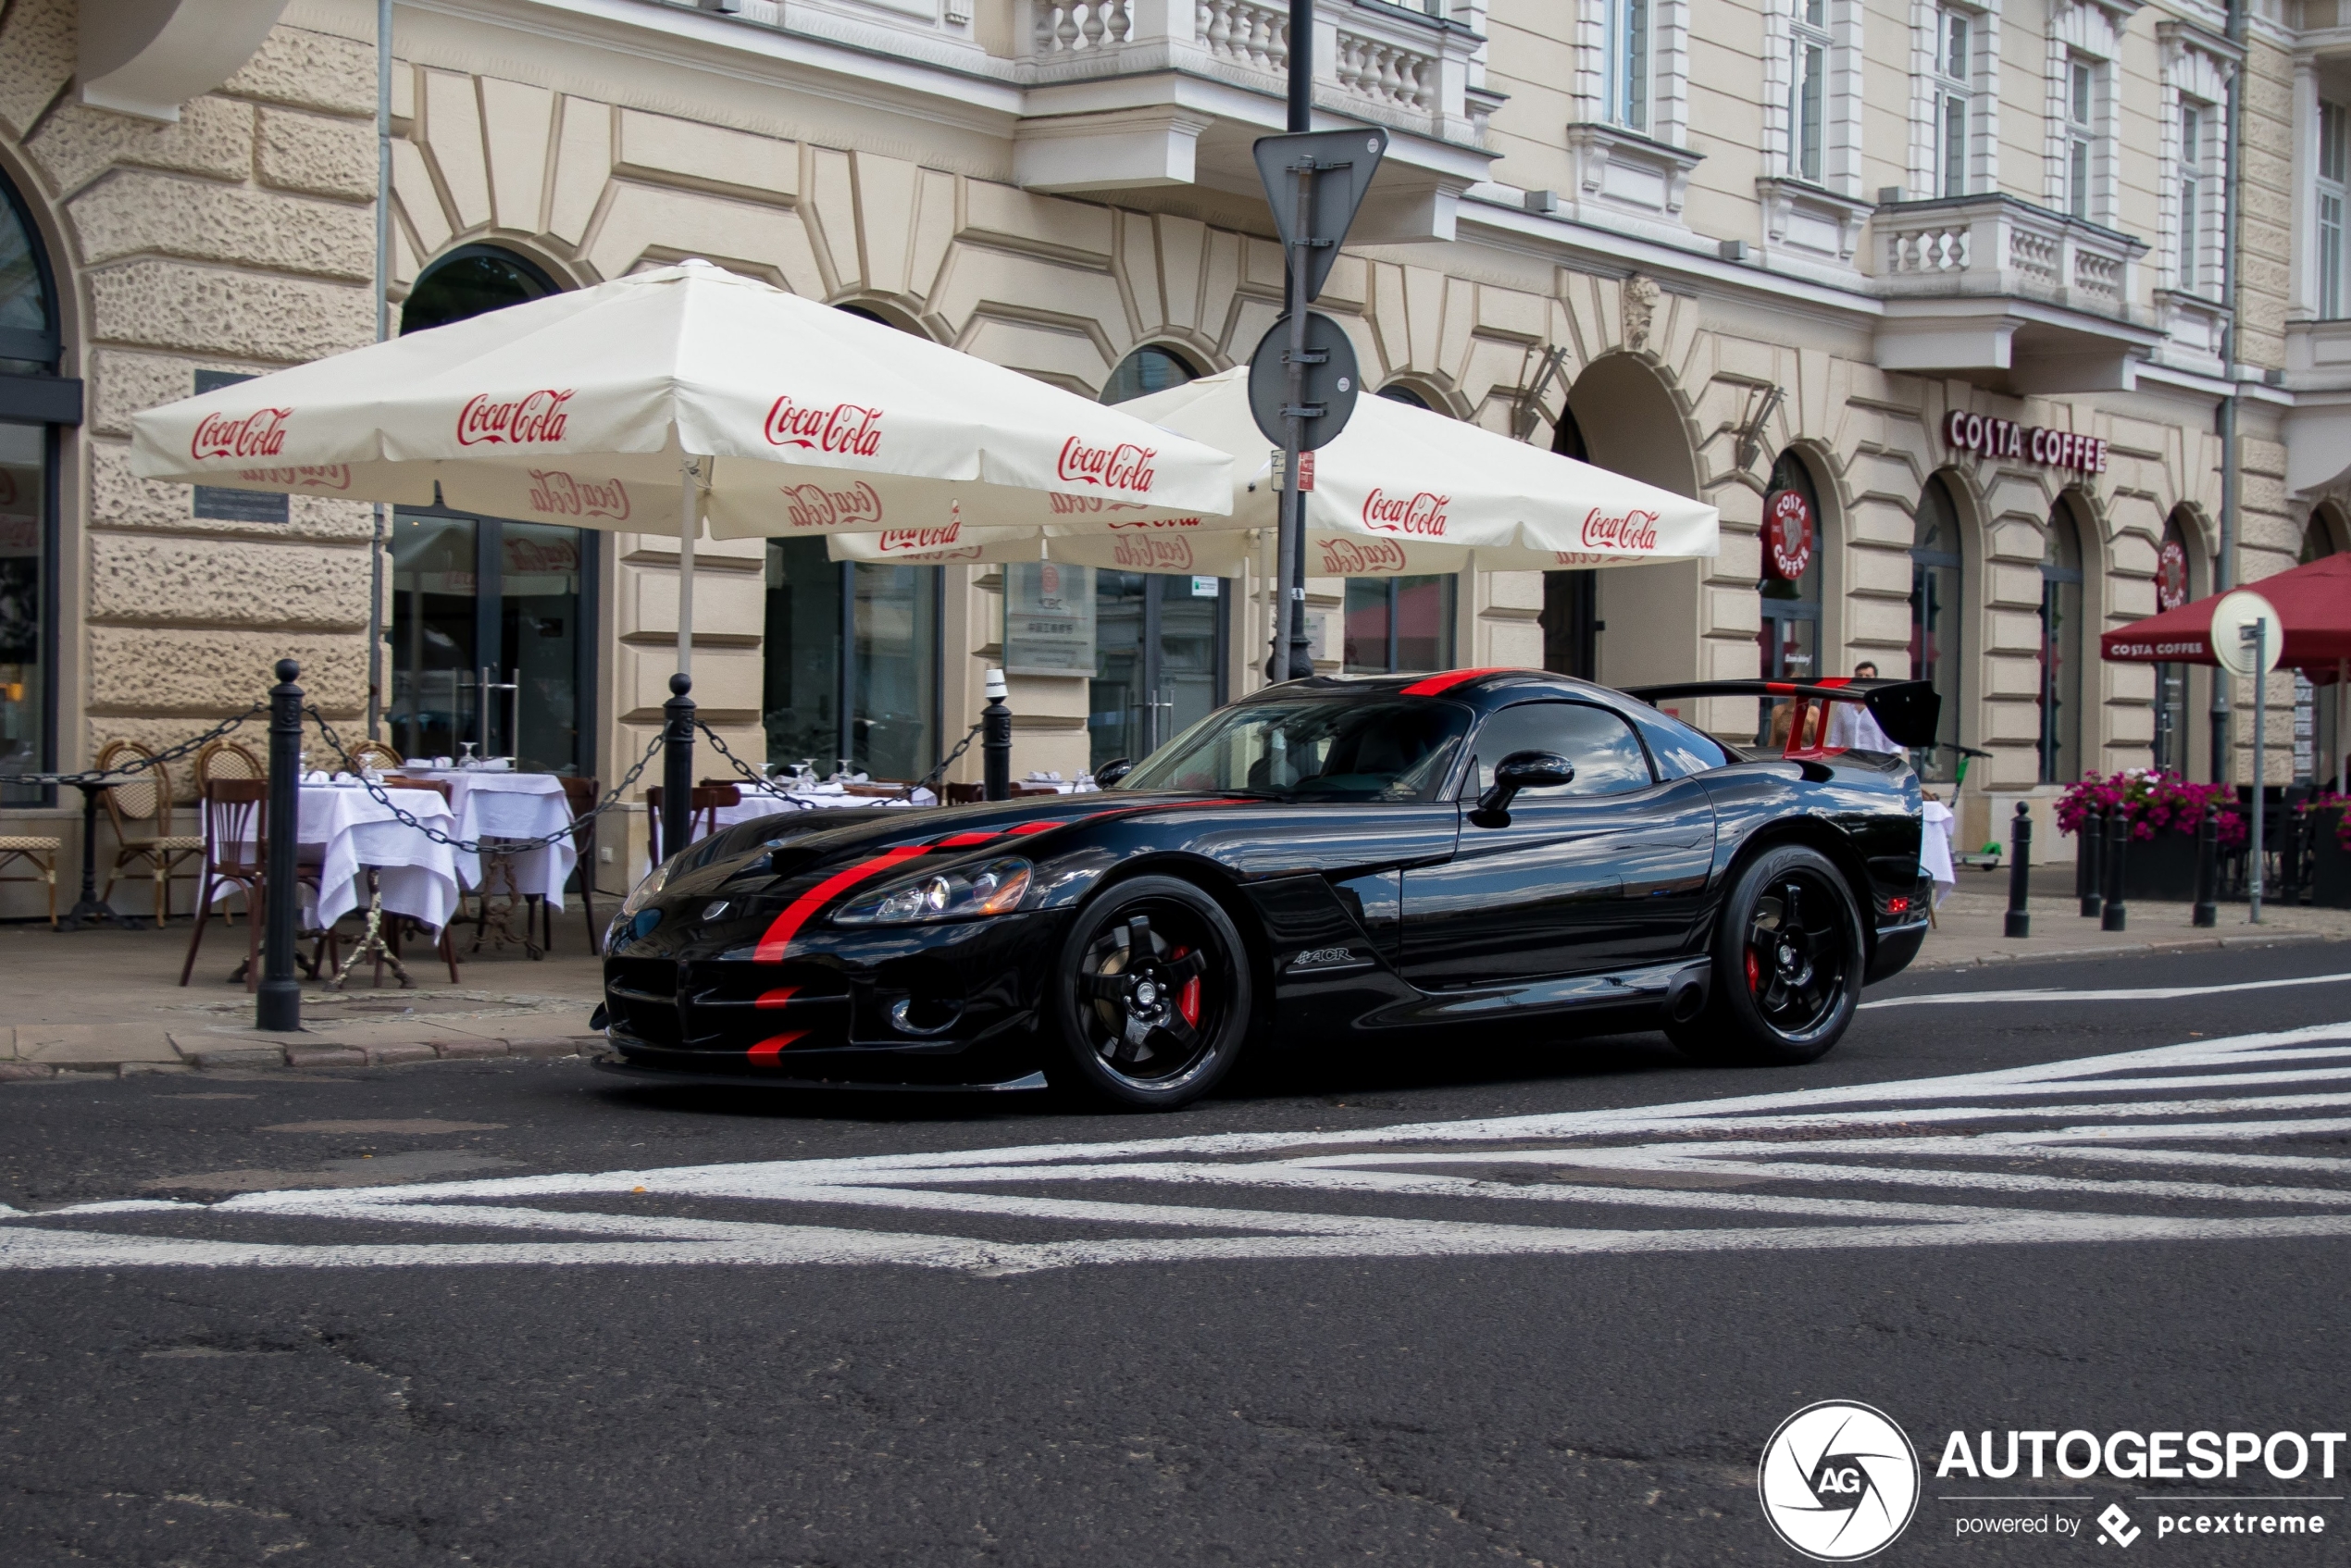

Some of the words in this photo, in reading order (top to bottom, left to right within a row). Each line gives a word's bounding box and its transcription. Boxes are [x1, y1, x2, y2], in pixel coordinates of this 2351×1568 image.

[192, 407, 295, 460] Coca-Cola
[457, 389, 579, 445] Coca-Cola
[764, 395, 884, 457] Coca-Cola
[1950, 410, 2021, 457] COSTA
[2032, 427, 2108, 473] COFFEE
[1057, 436, 1158, 493] Coca-Cola
[1362, 488, 1452, 537] Coca-Cola
[1582, 507, 1661, 550] Coca-Cola
[1776, 493, 1807, 520] COSTA
[1774, 544, 1810, 576] COFFEE
[2111, 644, 2153, 656] COSTA
[2156, 642, 2204, 655] COFFEE
[1301, 947, 1356, 963] ACR
